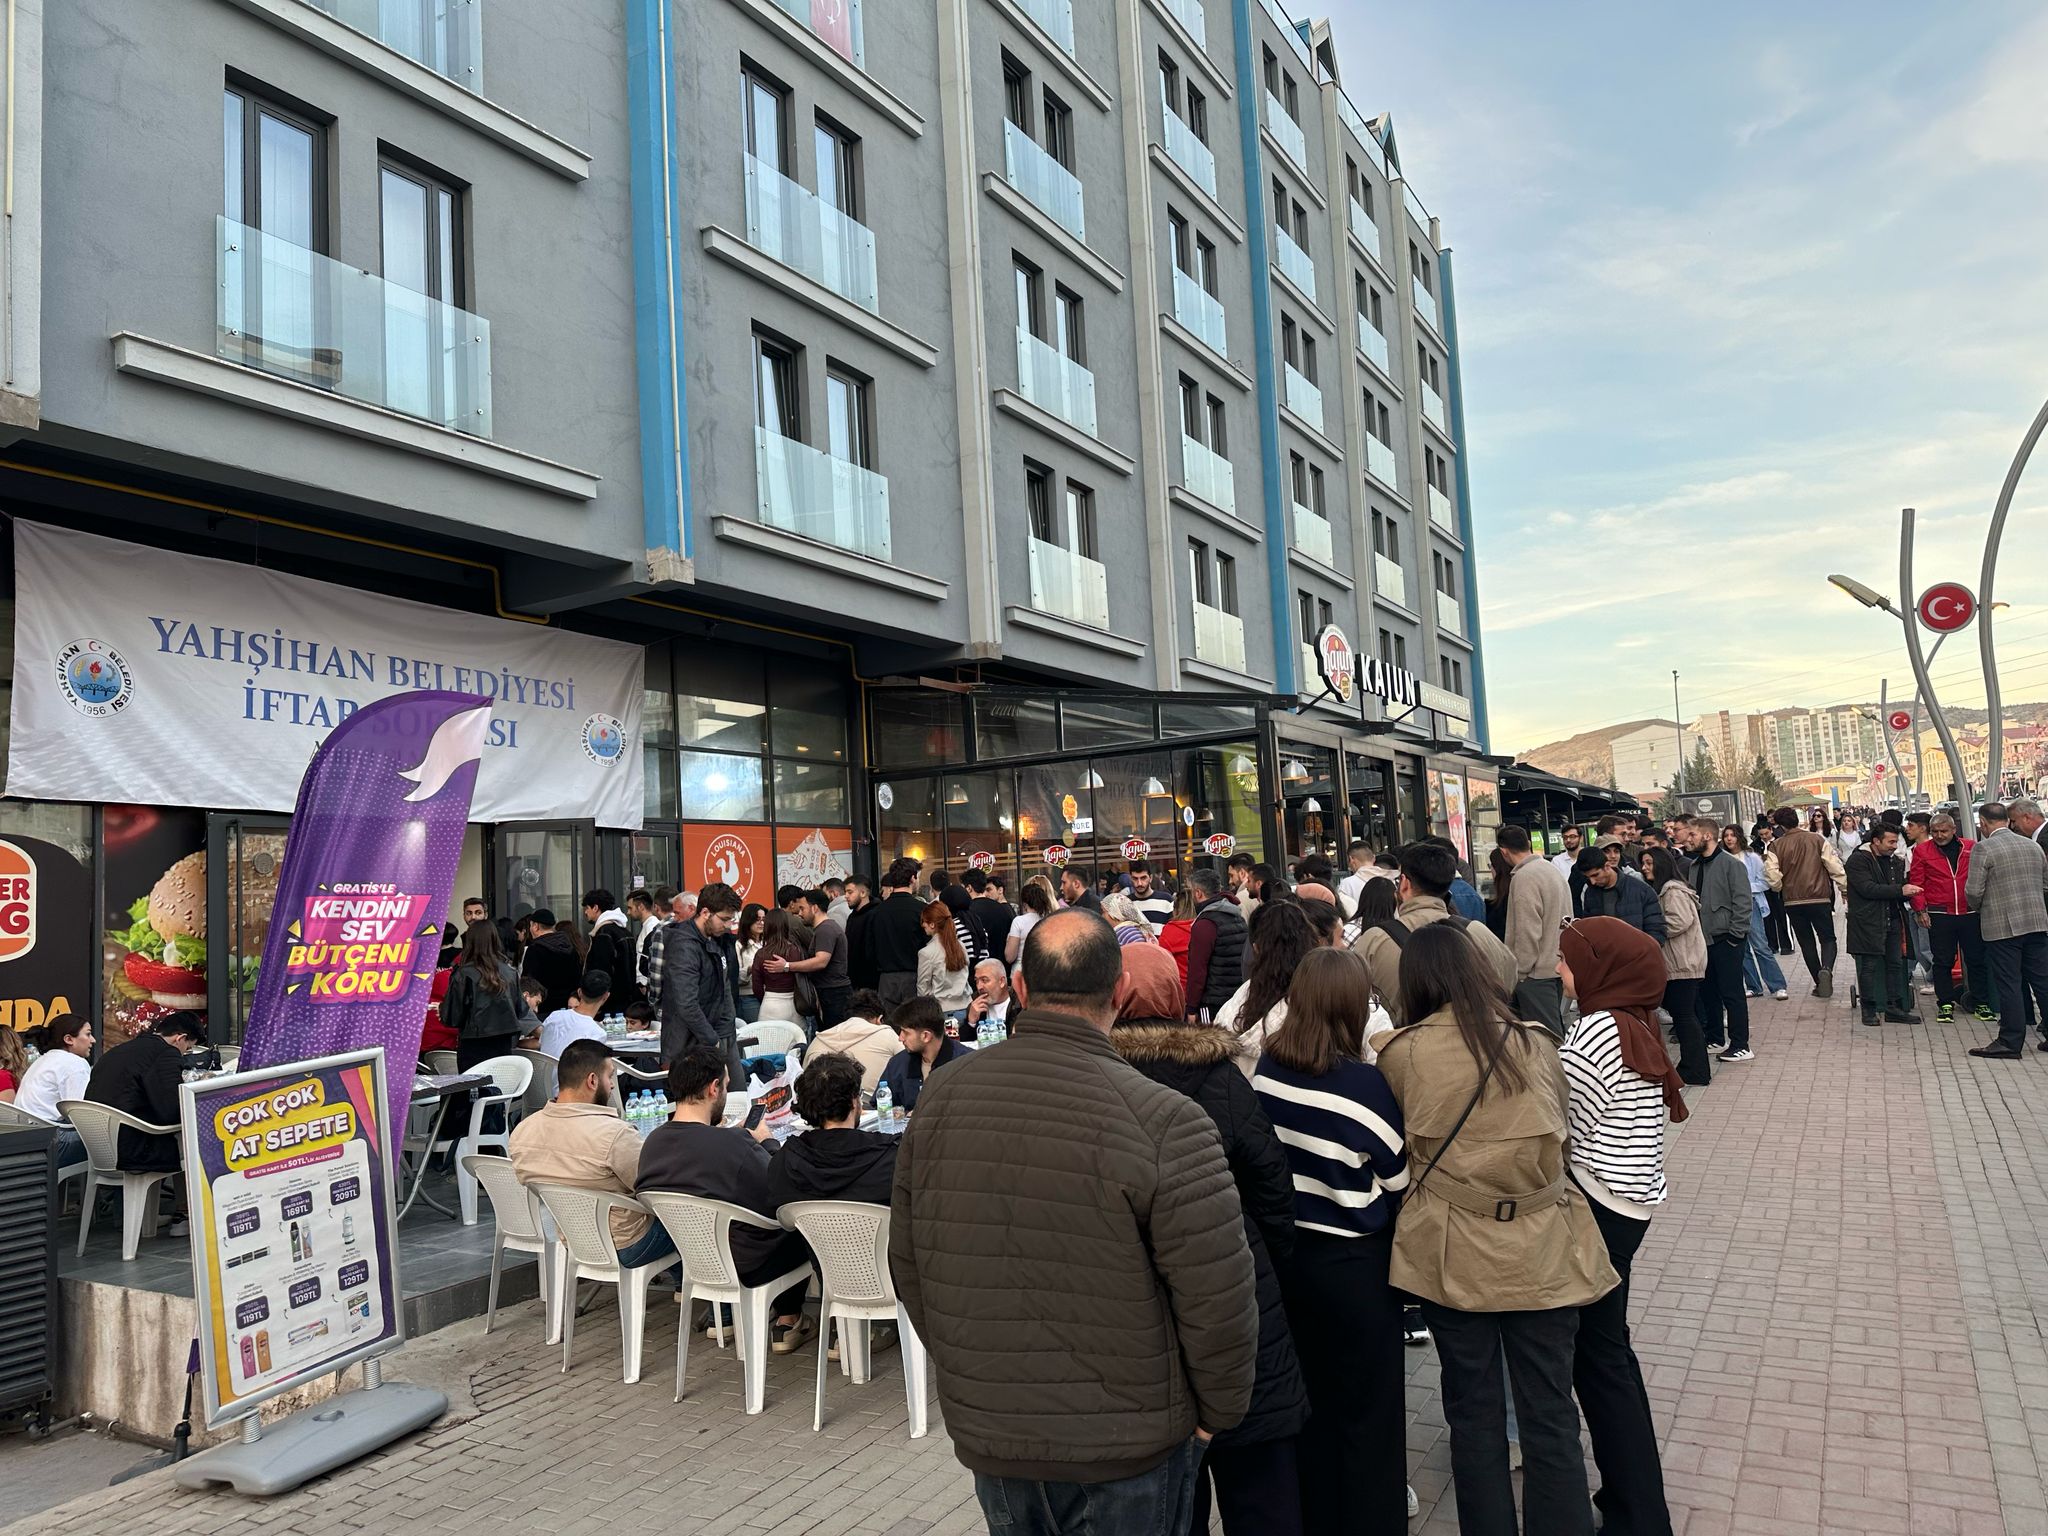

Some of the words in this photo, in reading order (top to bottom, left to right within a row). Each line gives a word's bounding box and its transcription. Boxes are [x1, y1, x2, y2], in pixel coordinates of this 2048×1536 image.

[148, 616, 376, 682] YAHŞİHAN
[387, 655, 576, 711] BELEDİYESİ
[1360, 652, 1416, 706] KAJUN
[82, 704, 107, 715] 1956
[242, 678, 360, 729] İFTAR
[710, 839, 746, 858] LOUISIANA
[333, 881, 397, 894] GRATİS'LE
[310, 895, 412, 918] KENDİNİ
[340, 920, 397, 941] SEV
[287, 937, 412, 971] BÜTÇENİ
[309, 970, 404, 995] KORU
[223, 1100, 269, 1133] ÇOK
[271, 1084, 317, 1116] ÇOK
[230, 1135, 261, 1161] AT
[265, 1112, 349, 1151] SEPETE
[335, 1189, 358, 1201] 209TL
[286, 1204, 309, 1217] 169TL
[232, 1221, 254, 1235] 119TL
[343, 1273, 364, 1287] 129TL
[294, 1290, 317, 1305] 109TL
[242, 1311, 264, 1325] 119TL
